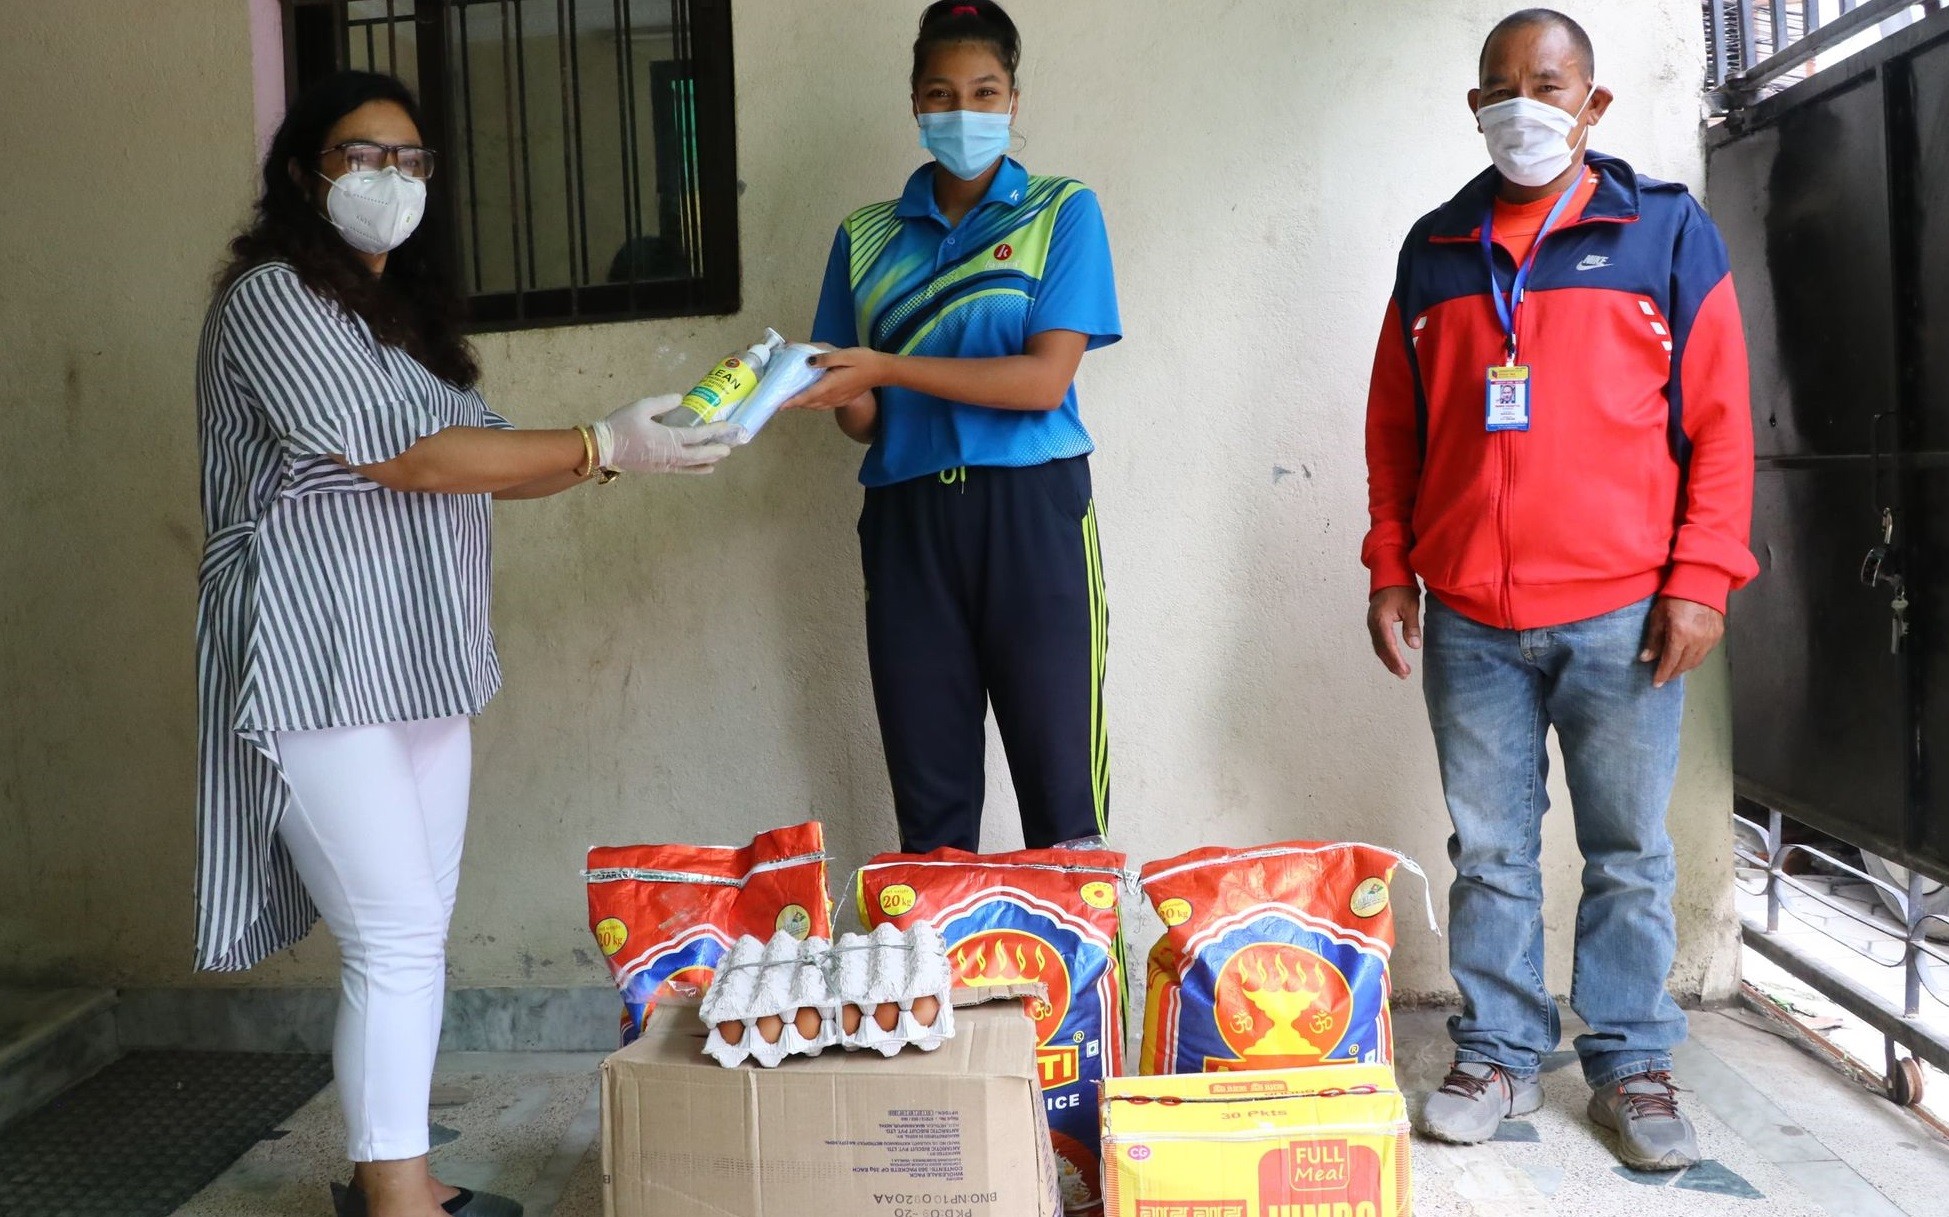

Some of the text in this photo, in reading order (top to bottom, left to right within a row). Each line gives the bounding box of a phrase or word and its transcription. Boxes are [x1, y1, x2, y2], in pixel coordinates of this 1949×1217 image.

[883, 894, 900, 908] 20
[1178, 909, 1188, 920] kg
[1042, 1093, 1080, 1111] ICE
[1129, 1147, 1149, 1158] CG
[1295, 1146, 1345, 1164] FULL
[1294, 1164, 1345, 1182] Meal
